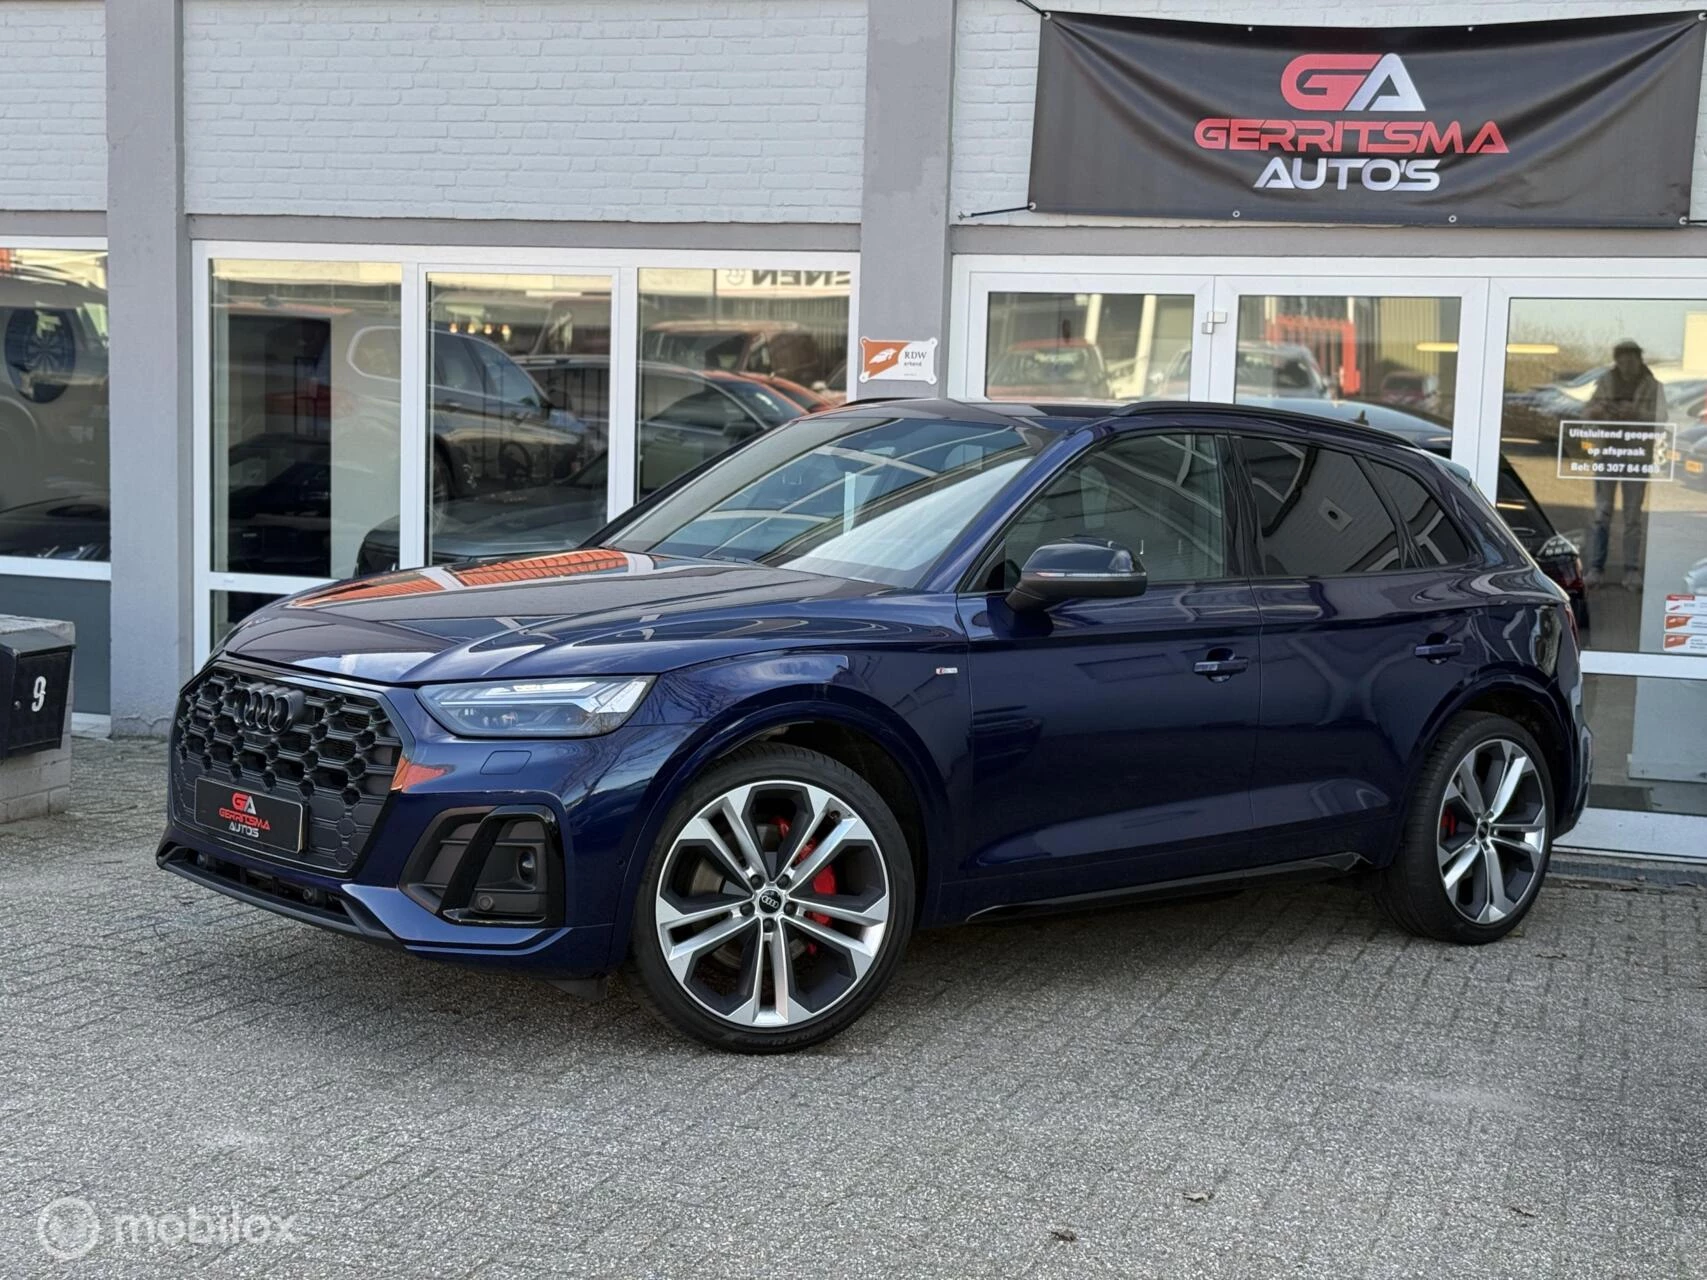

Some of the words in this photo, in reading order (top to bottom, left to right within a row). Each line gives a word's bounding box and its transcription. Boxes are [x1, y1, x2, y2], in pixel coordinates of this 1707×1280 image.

[1280, 52, 1427, 112] GA
[1194, 117, 1510, 154] GERRITSMA
[1253, 156, 1441, 192] AUTO'S
[904, 351, 927, 360] RDW
[1569, 428, 1622, 438] Uitsluitend
[1624, 432, 1666, 441] geopend
[1587, 448, 1600, 456] op
[1602, 446, 1645, 457] afspraak
[1570, 462, 1590, 471] Bel:
[1592, 463, 1605, 472] 06
[1606, 464, 1625, 472] 307
[1627, 464, 1640, 473] 84
[31, 675, 47, 712] 9
[232, 792, 257, 815] GA
[218, 807, 271, 831] GERRITSMA
